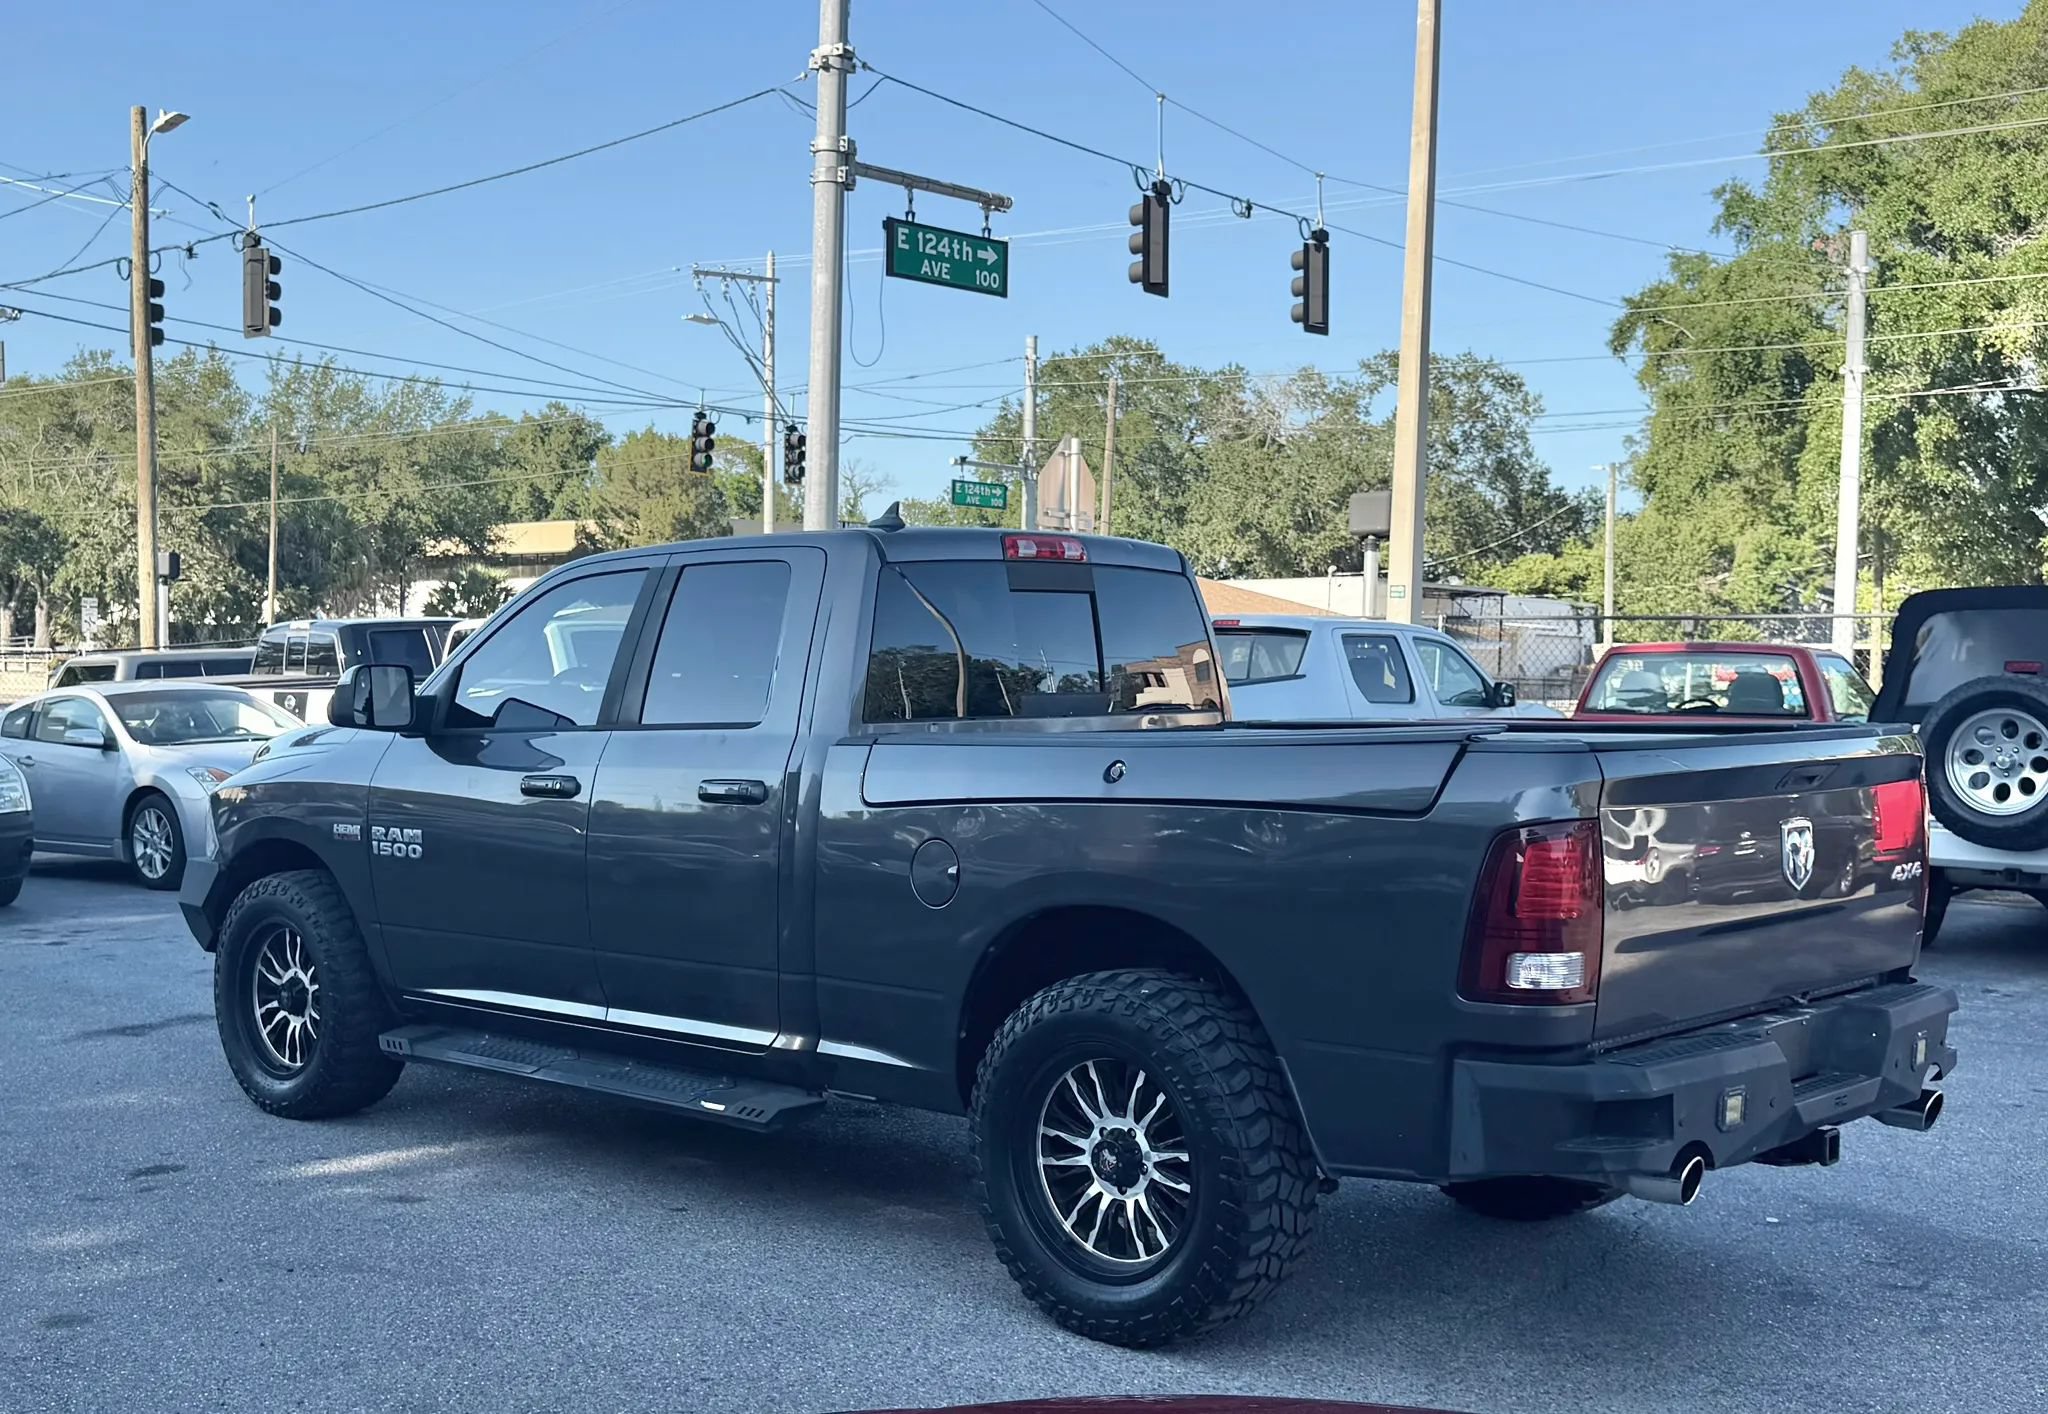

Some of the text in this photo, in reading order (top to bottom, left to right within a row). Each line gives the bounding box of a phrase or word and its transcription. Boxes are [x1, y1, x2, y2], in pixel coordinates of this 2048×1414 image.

[897, 227, 973, 262] E 124th
[920, 259, 999, 289] AVE 100
[956, 482, 991, 496] E 124th
[966, 494, 981, 505] AVE
[371, 826, 423, 844] RAM
[371, 841, 423, 859] 1500
